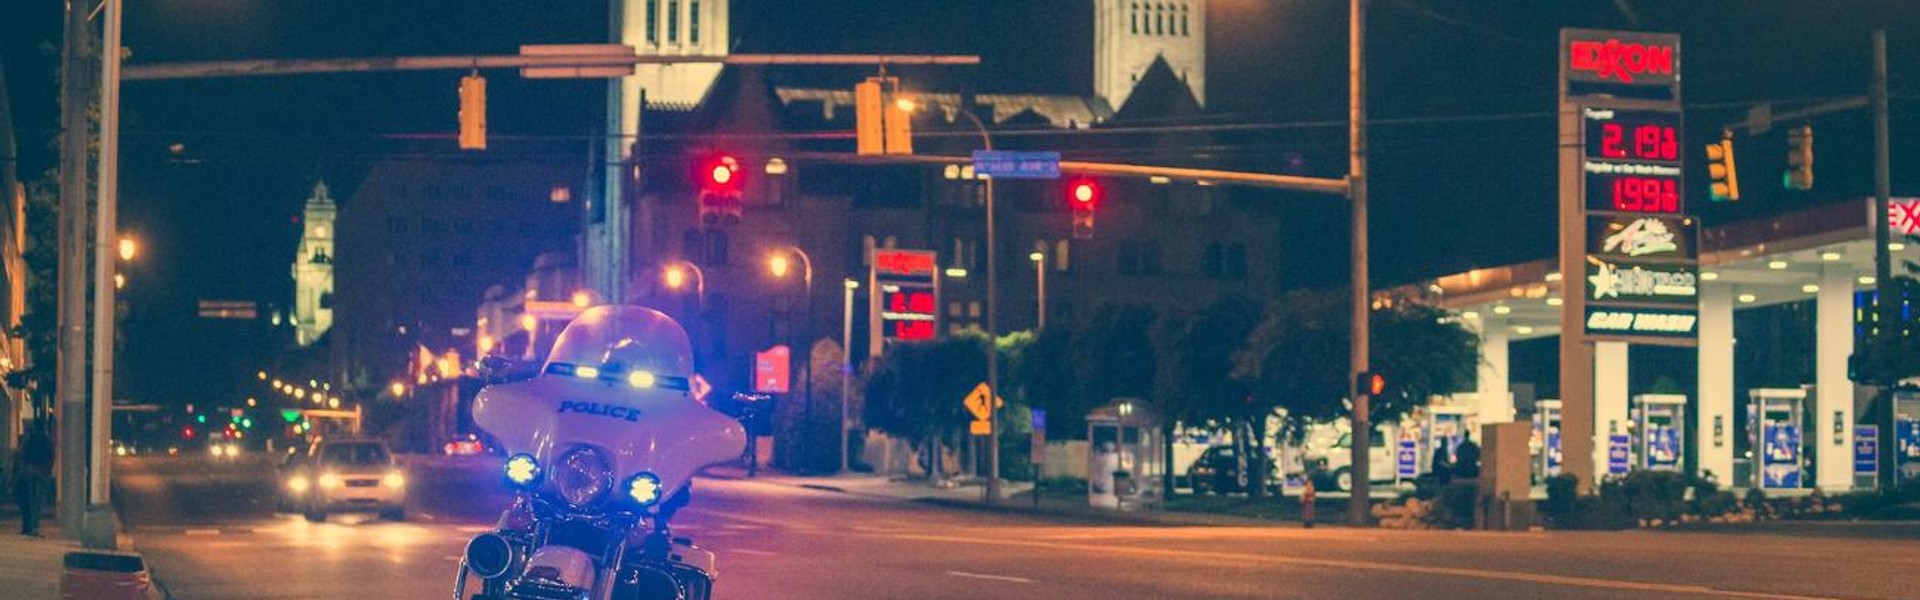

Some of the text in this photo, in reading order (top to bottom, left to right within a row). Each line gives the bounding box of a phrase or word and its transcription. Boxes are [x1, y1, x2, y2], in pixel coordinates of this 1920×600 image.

[1571, 39, 1672, 83] EXXON
[1587, 312, 1634, 329] CAR
[558, 401, 641, 422] POLICE
